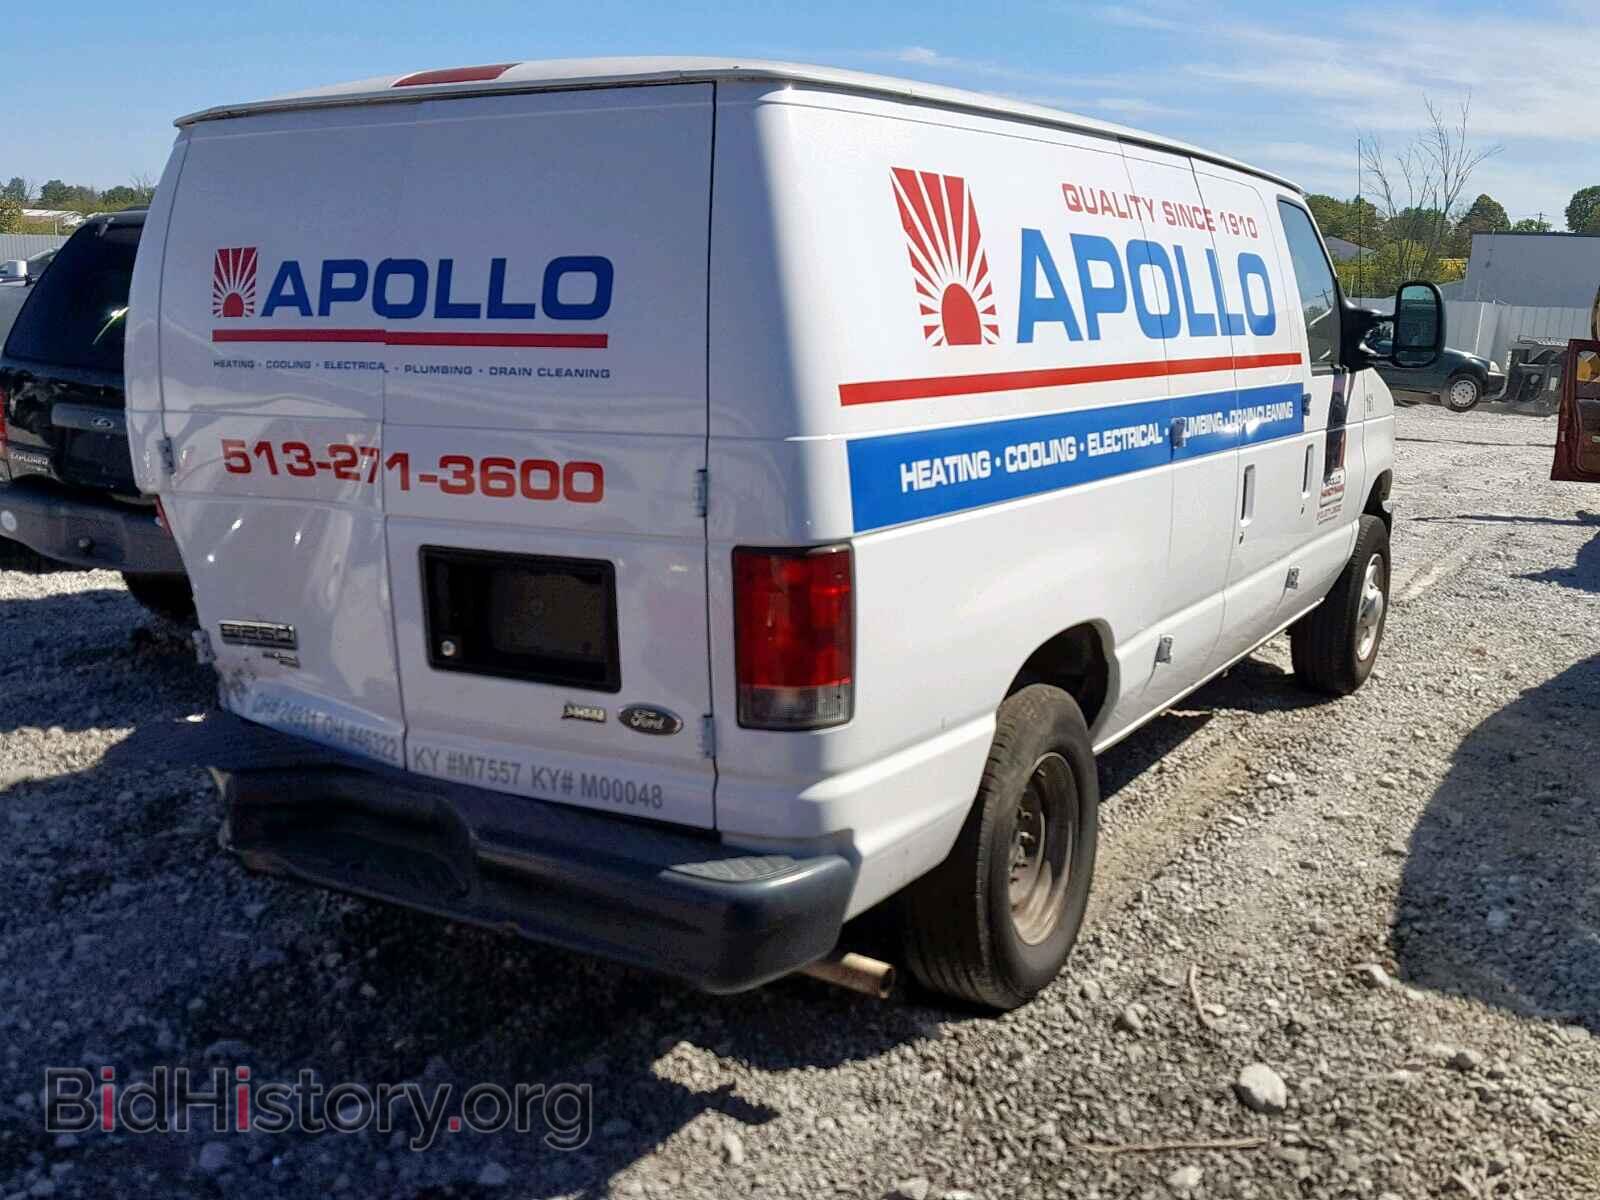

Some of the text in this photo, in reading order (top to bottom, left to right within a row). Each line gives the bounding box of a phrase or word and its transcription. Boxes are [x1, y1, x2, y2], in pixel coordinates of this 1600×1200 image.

[1061, 183, 1259, 239] QUALITY SINCE 1910
[260, 255, 614, 321] APOLLO
[1017, 227, 1276, 344] APOLLO
[213, 359, 255, 369] HEATING
[266, 360, 312, 370] COOLING
[404, 364, 473, 376] PLUMBING
[489, 367, 533, 377] DRAIN
[537, 368, 611, 379] CLEANING
[221, 438, 605, 504] 513-271-3600
[900, 450, 991, 493] HEATING
[1004, 436, 1077, 473] COOLING
[1086, 422, 1163, 457] ELECTRICAL
[1171, 411, 1223, 438] UMBING
[413, 746, 663, 810] KY #M7557 KY# M00048
